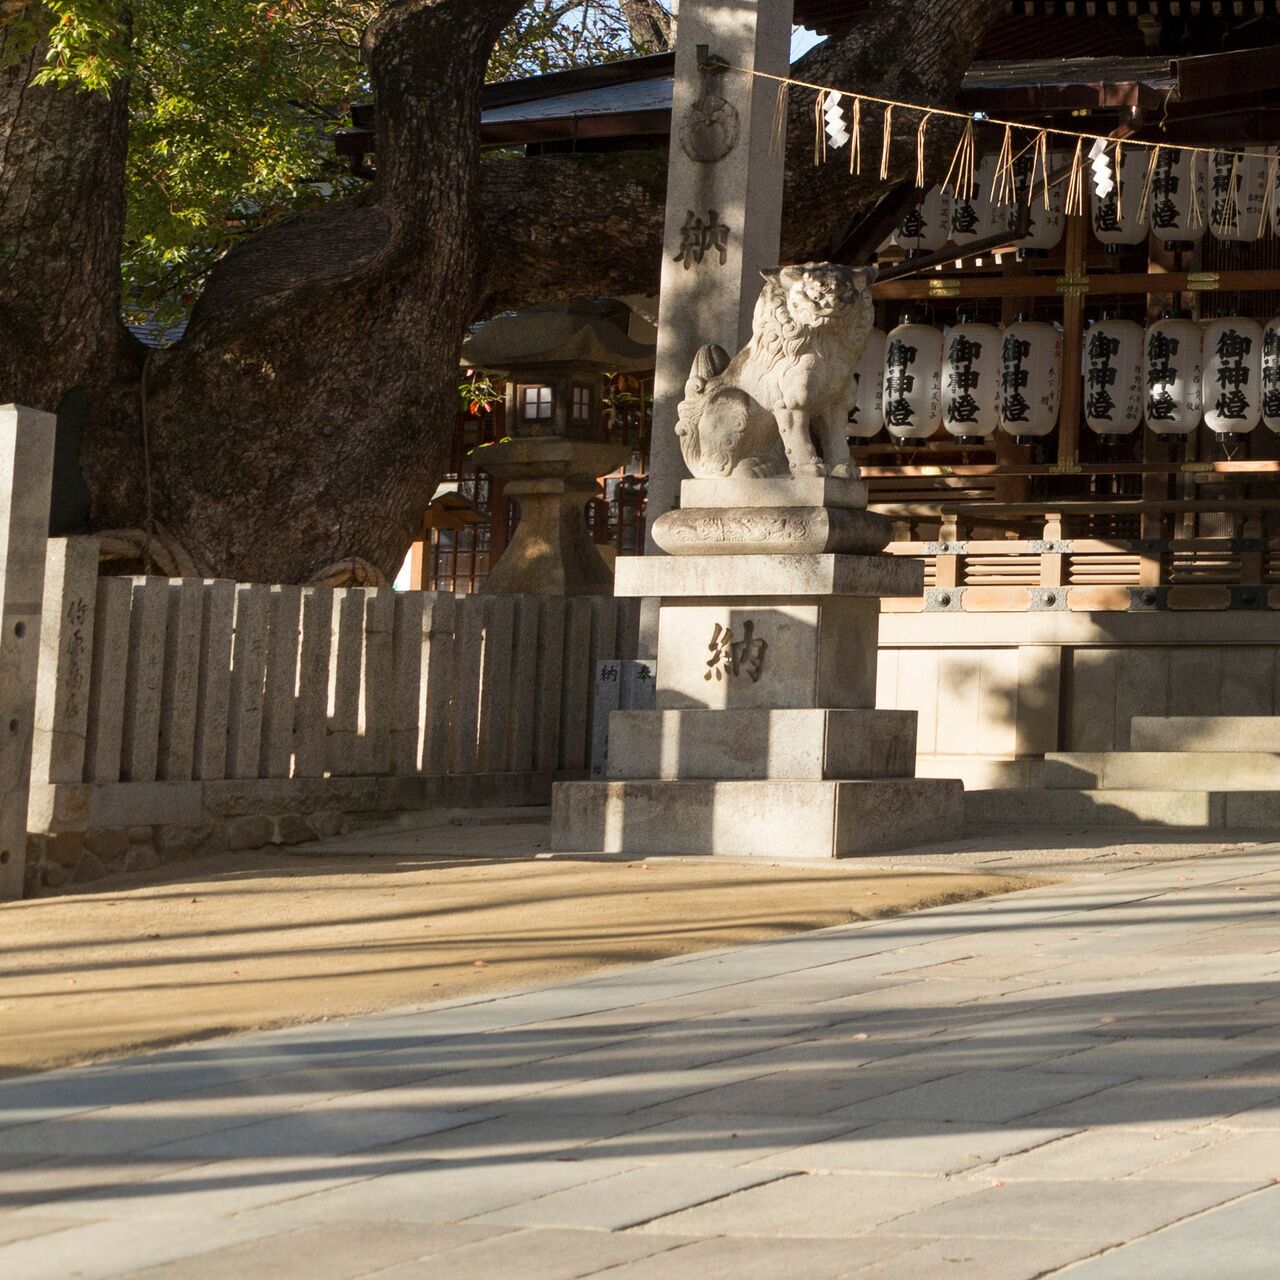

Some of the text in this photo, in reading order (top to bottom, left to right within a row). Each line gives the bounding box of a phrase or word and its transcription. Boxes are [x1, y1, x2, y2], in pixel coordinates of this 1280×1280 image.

[673, 210, 731, 270] 納
[886, 338, 918, 427] 御神燈
[947, 334, 983, 424] 御神燈
[1001, 333, 1032, 423] 御神燈
[1086, 331, 1121, 421] 御神燈
[1147, 331, 1180, 421] 御神燈
[1215, 328, 1253, 421] 御神燈
[600, 664, 618, 682] 納
[704, 620, 768, 683] 納
